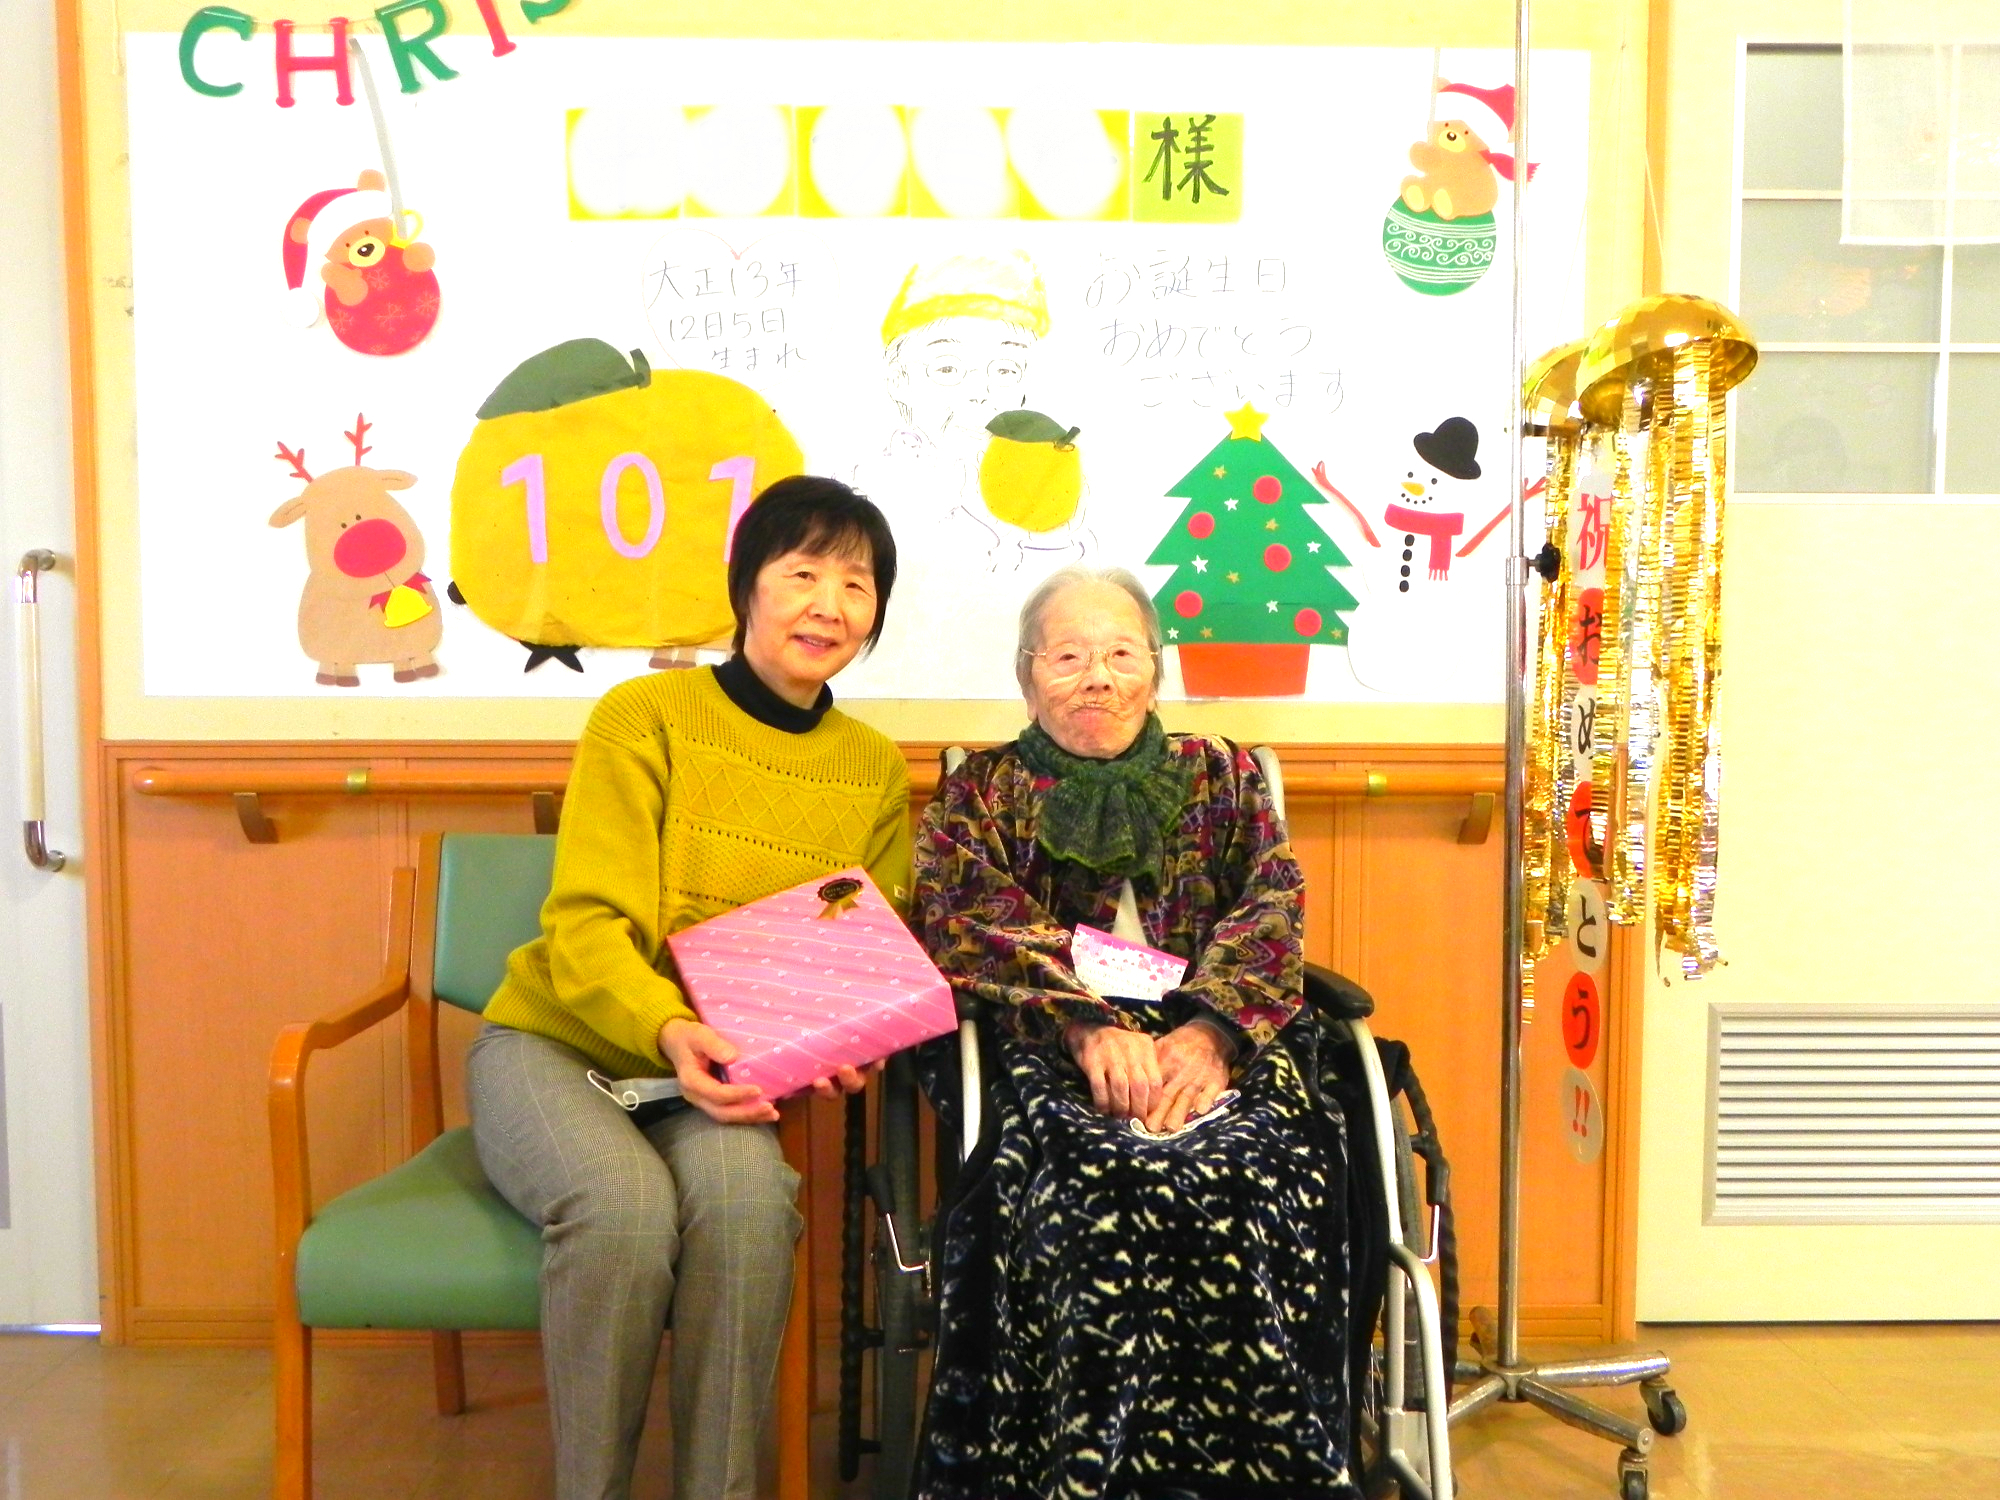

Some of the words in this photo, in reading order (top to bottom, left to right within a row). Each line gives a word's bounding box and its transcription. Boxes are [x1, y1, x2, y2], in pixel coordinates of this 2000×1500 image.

[1142, 114, 1230, 204] 様
[648, 260, 803, 310] 大正13年
[1086, 250, 1286, 308] お誕生日
[712, 342, 807, 371] 生まれ
[1100, 317, 1313, 367] おめでとう
[1140, 367, 1344, 414] ございます
[501, 452, 756, 564] 101
